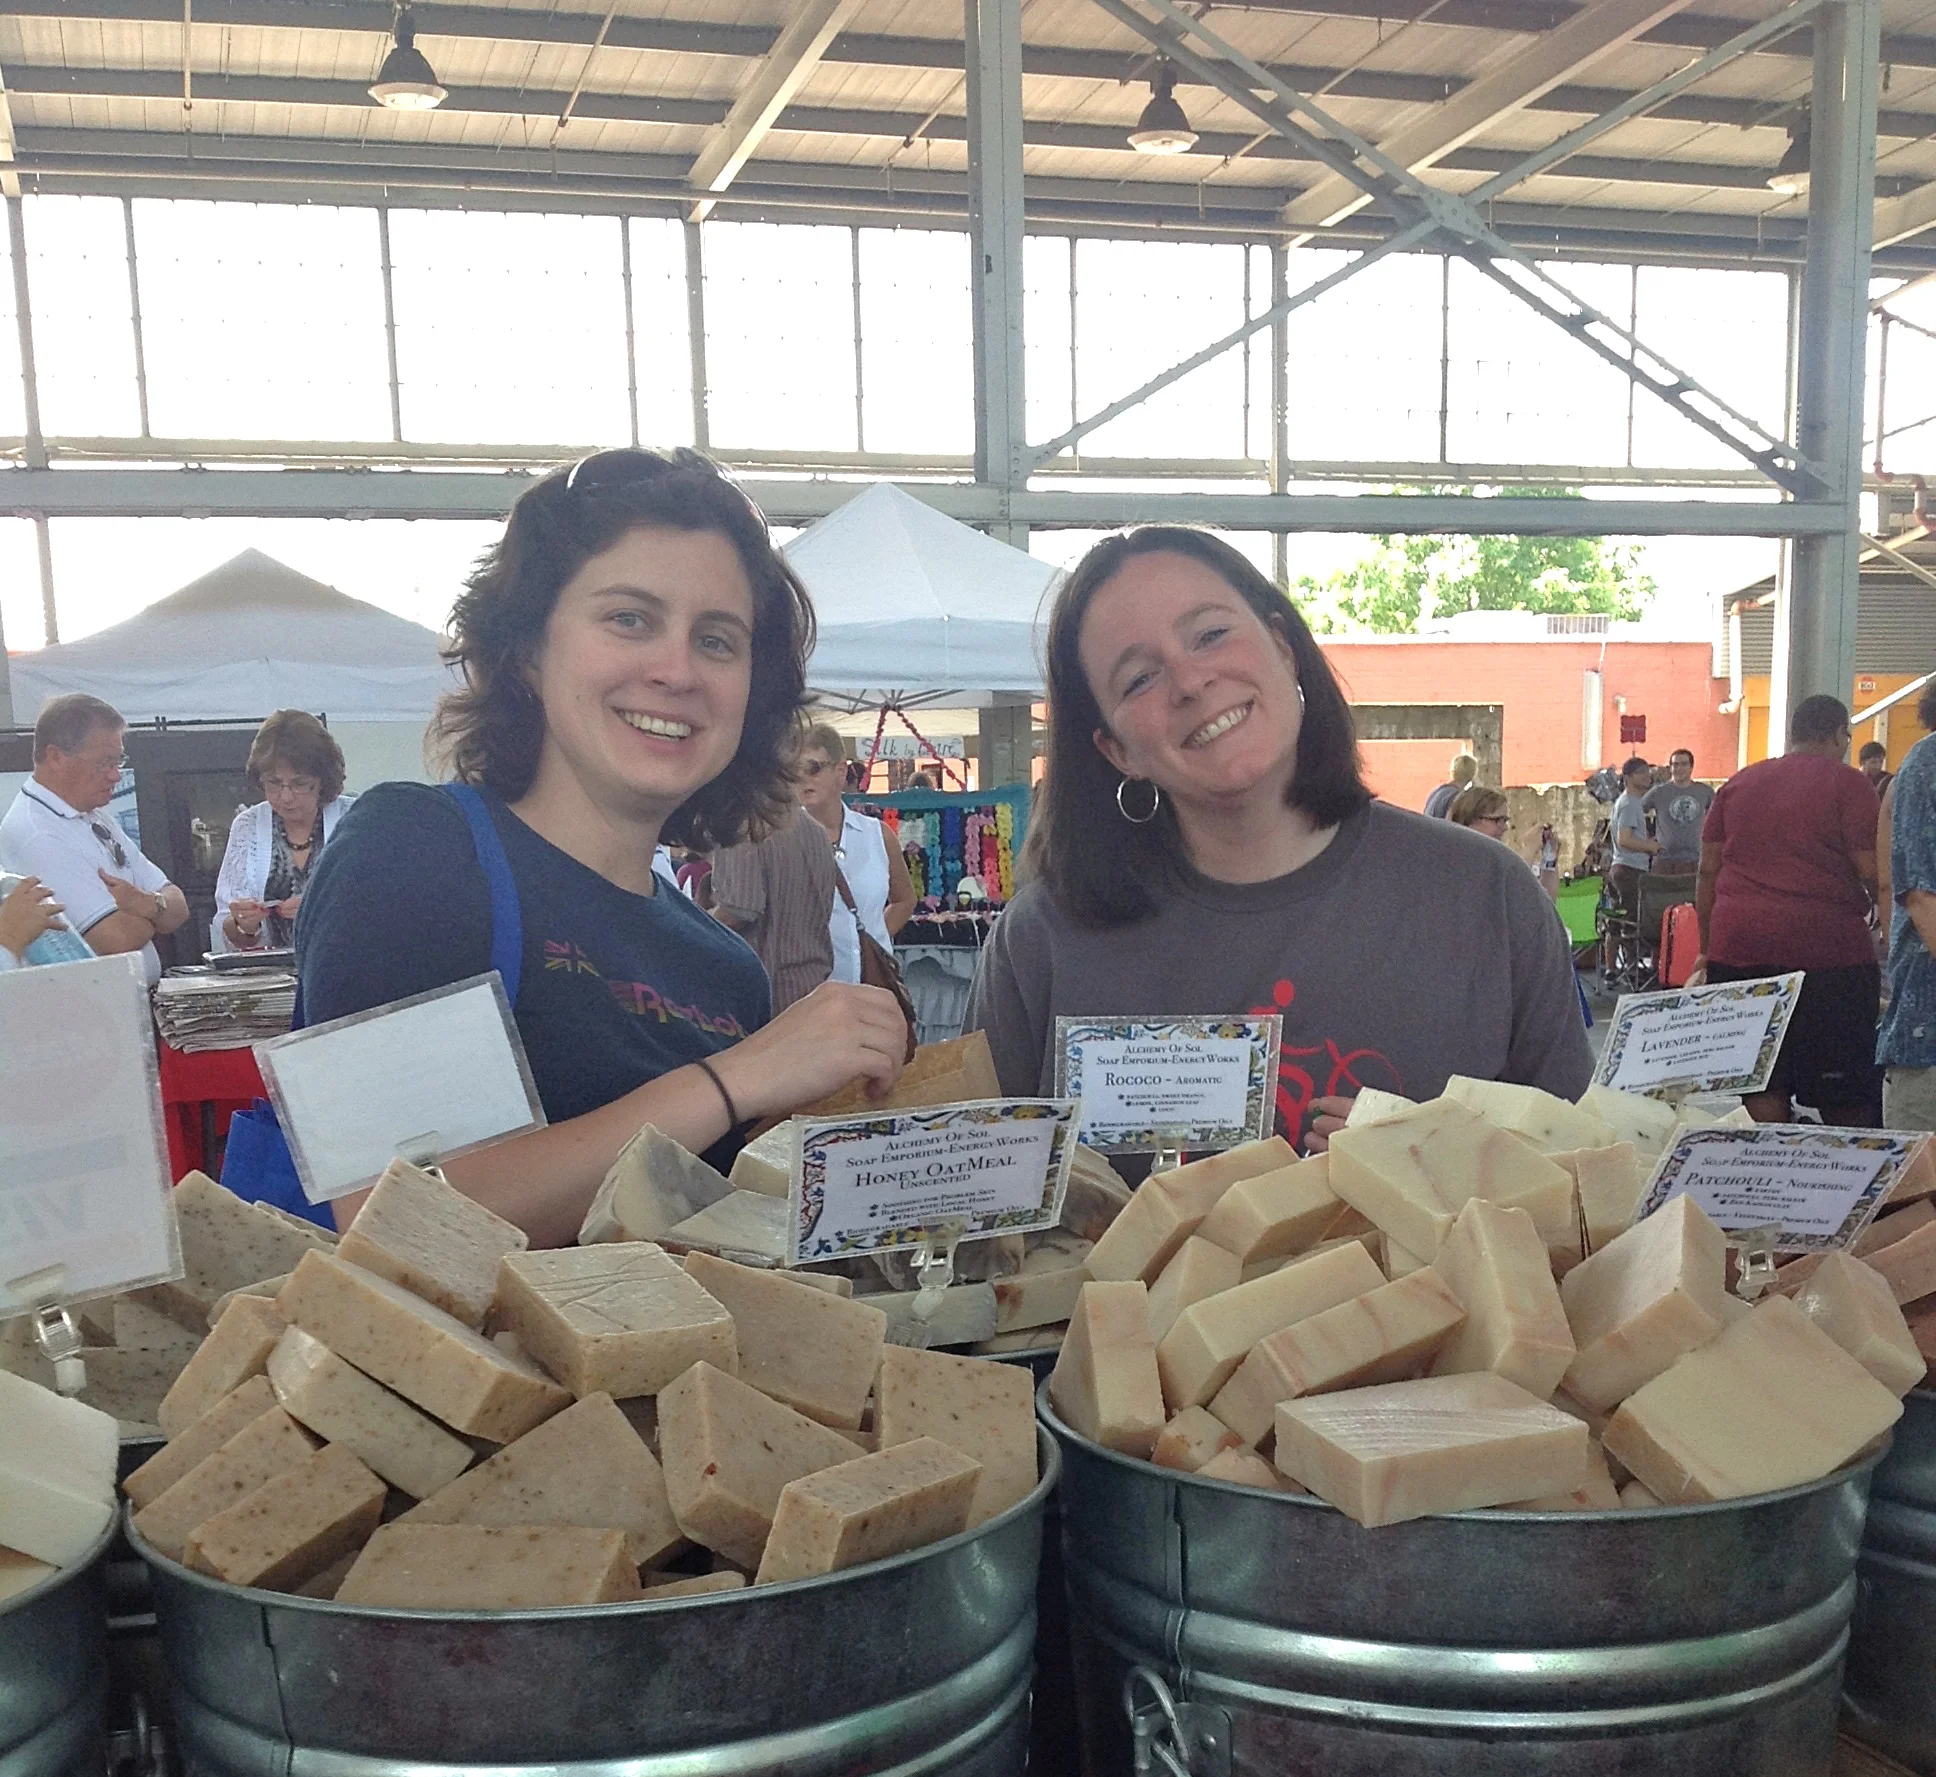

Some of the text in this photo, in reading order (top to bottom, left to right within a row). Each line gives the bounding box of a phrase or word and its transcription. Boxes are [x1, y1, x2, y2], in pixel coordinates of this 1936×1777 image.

[861, 737, 897, 756] Slk
[1641, 1033, 1702, 1053] LAVENDER
[1105, 1072, 1162, 1087] ROCOCO
[855, 1155, 1017, 1188] HONEY OATMEAL
[1684, 1172, 1772, 1186] PATCHOULI
[900, 1173, 972, 1190] UNSCENTED
